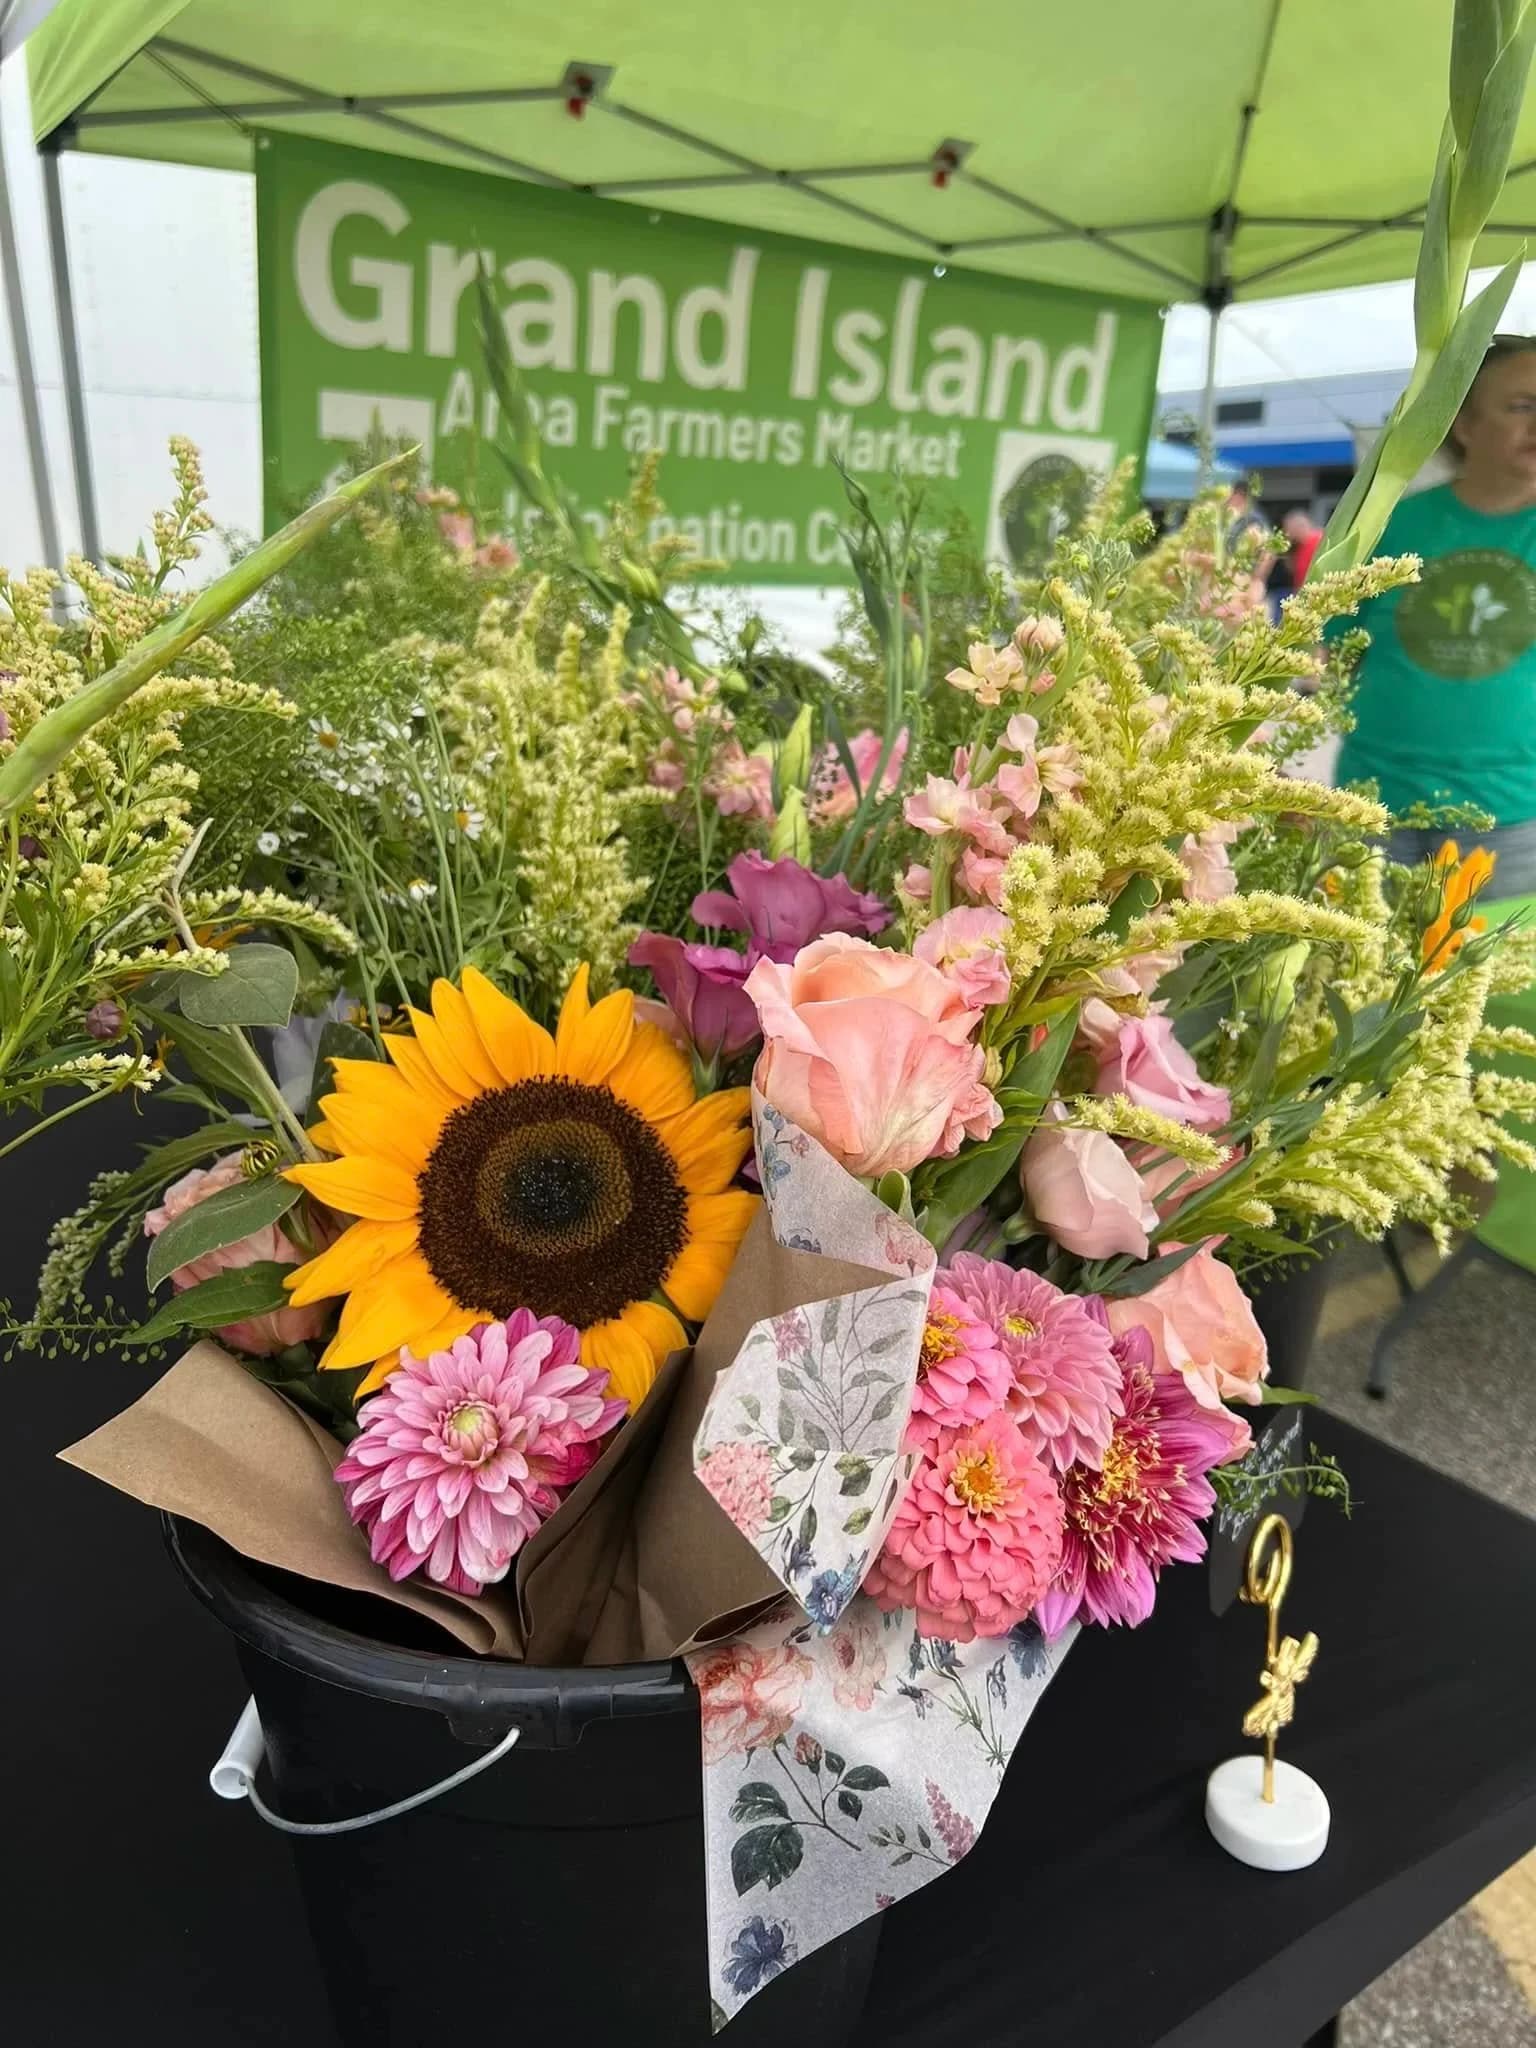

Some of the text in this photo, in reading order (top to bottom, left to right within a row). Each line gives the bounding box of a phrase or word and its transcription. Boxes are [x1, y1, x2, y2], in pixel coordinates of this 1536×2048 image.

[294, 181, 1117, 431] Grand Island
[591, 384, 804, 466] Farmers
[812, 408, 963, 478] Market
